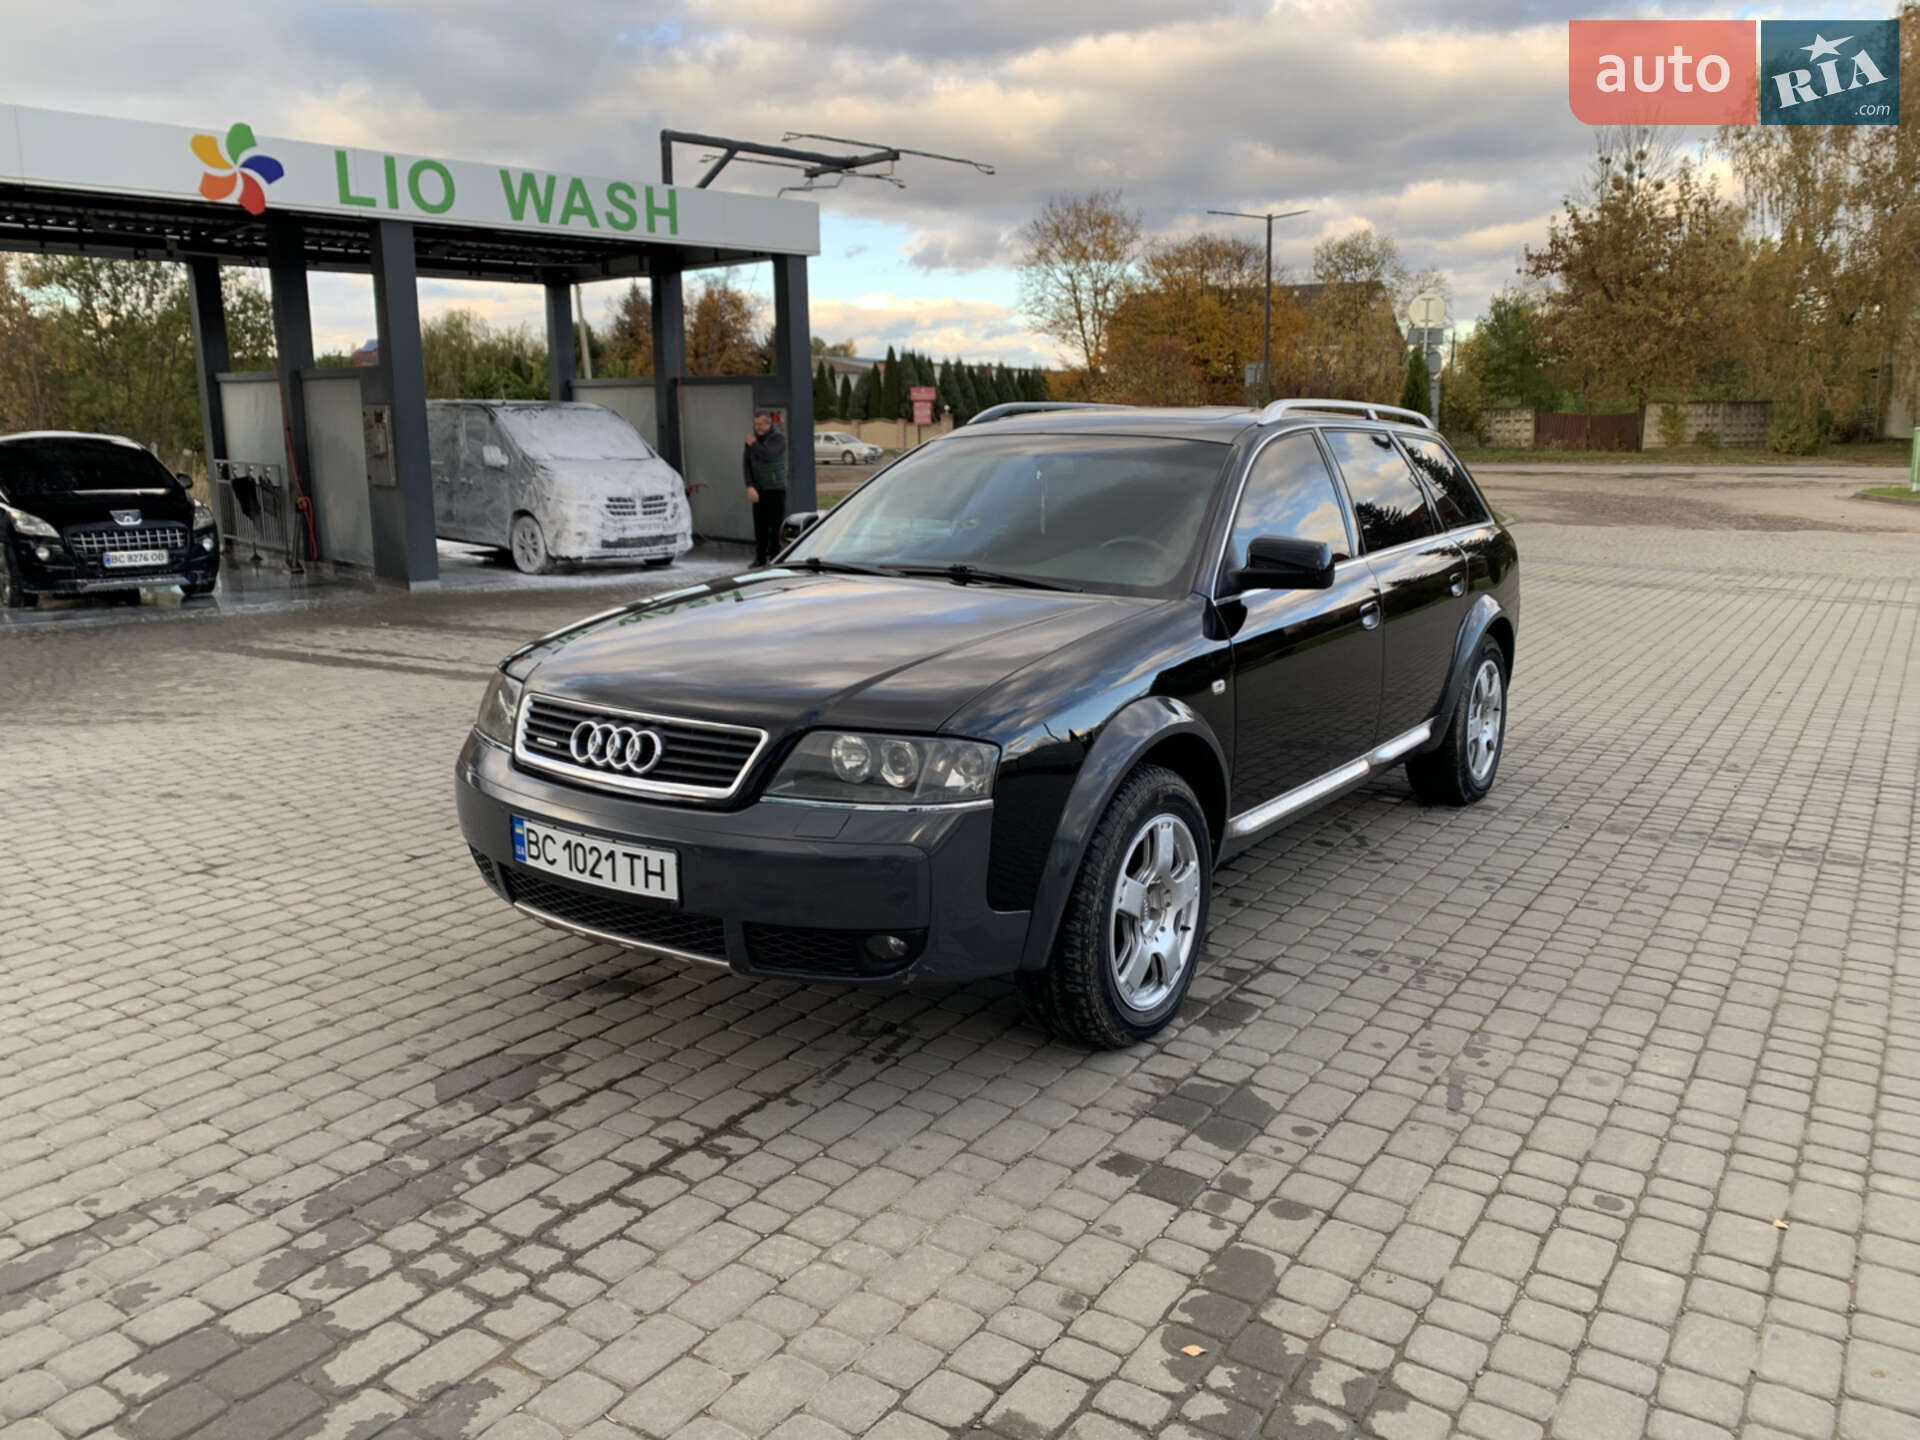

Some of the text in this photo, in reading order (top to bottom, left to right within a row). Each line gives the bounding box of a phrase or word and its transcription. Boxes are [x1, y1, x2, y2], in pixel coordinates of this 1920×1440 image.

[334, 150, 679, 235] LIO WASH
[526, 828, 666, 891] BC 1021 TH
